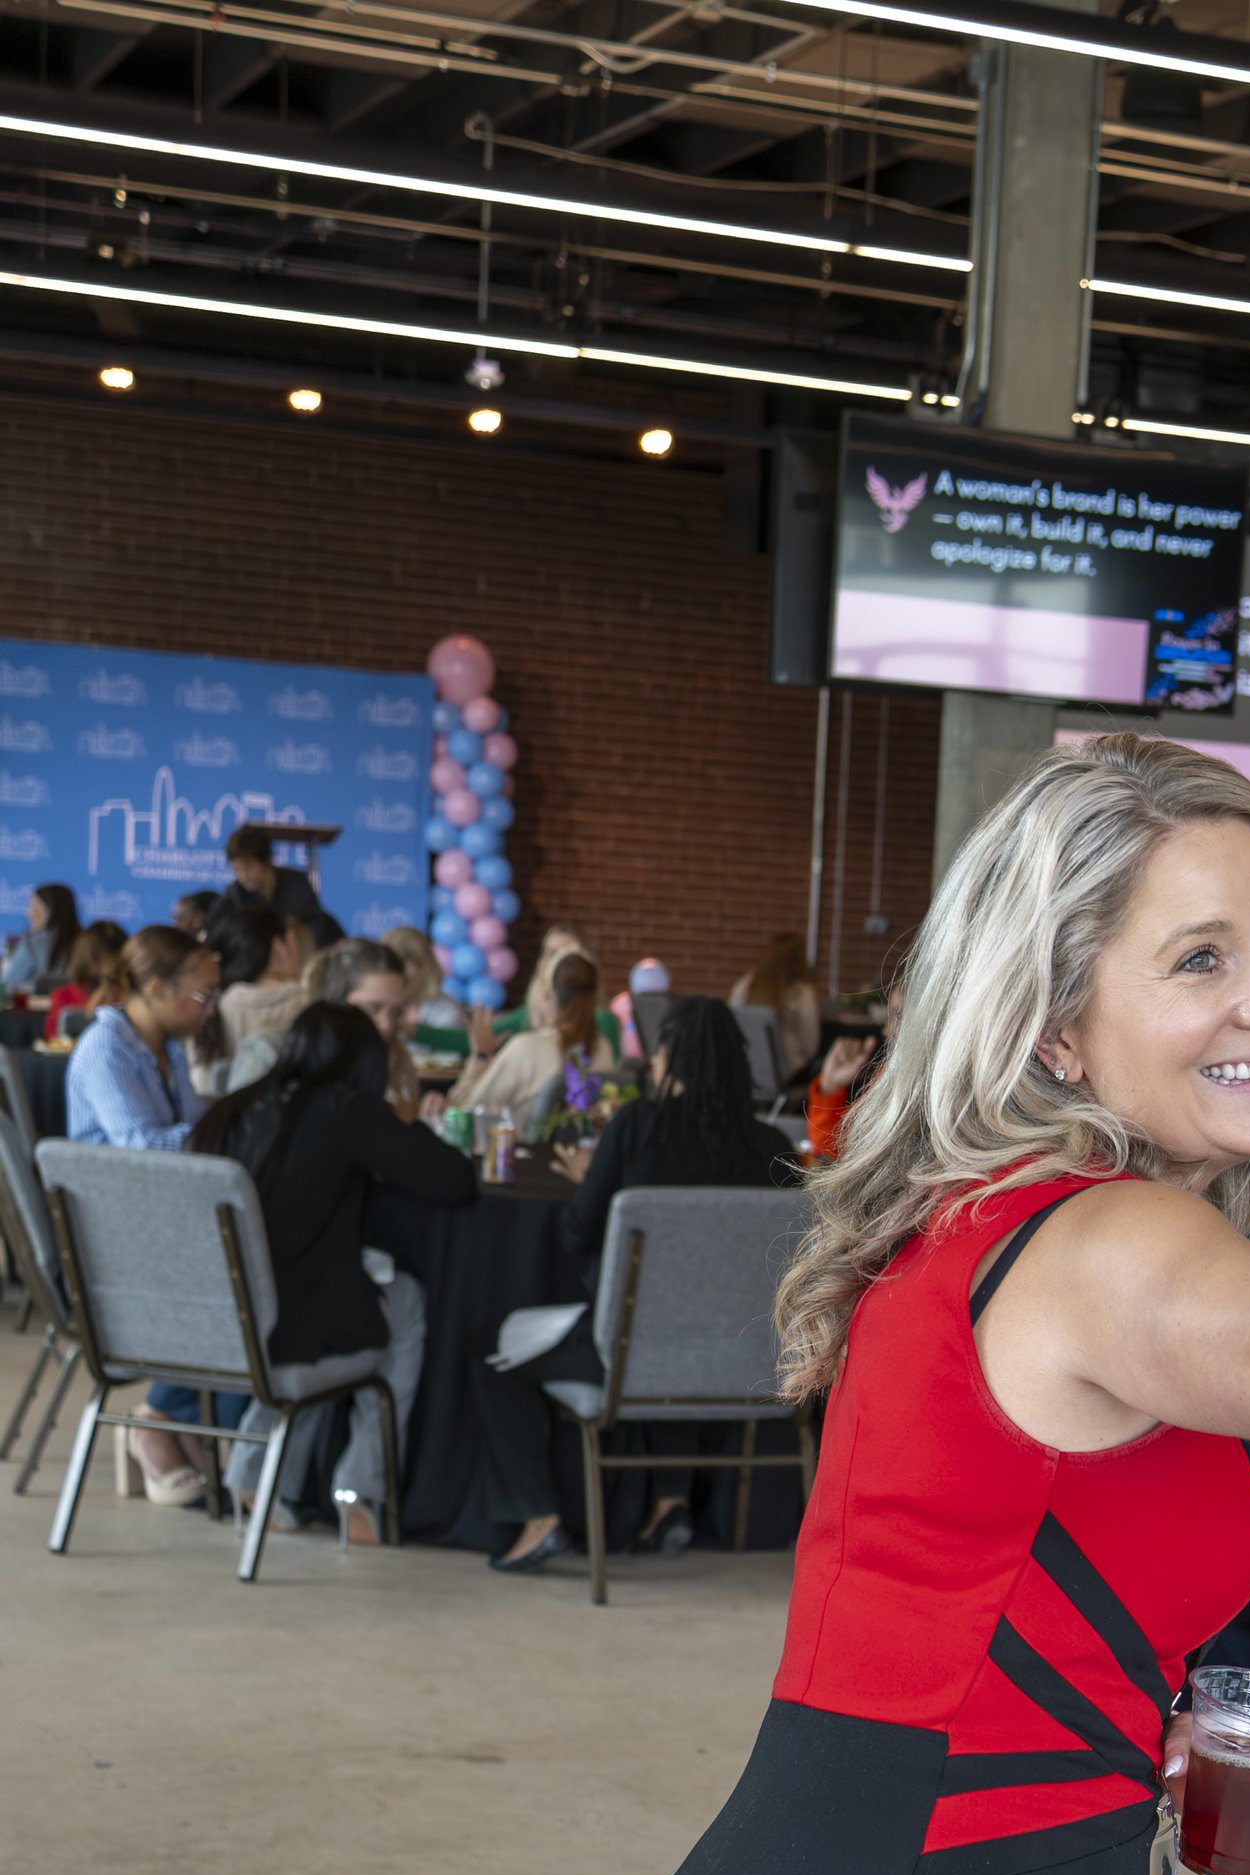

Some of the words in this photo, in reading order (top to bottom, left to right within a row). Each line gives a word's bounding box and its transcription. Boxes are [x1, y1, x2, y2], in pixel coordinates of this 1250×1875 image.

[934, 470, 953, 496] A
[957, 479, 1049, 508] woman's
[1052, 482, 1116, 515] brand
[1117, 494, 1136, 518] is
[1138, 493, 1174, 522] her
[1175, 505, 1241, 529] power
[931, 538, 1036, 573] apologize
[1041, 545, 1072, 573] for
[1074, 552, 1096, 576] it.
[956, 511, 1002, 533] own
[1005, 512, 1028, 539] it,
[1031, 512, 1084, 543] build
[1087, 522, 1108, 549] it,
[1110, 525, 1153, 551] and
[1155, 534, 1213, 558] never
